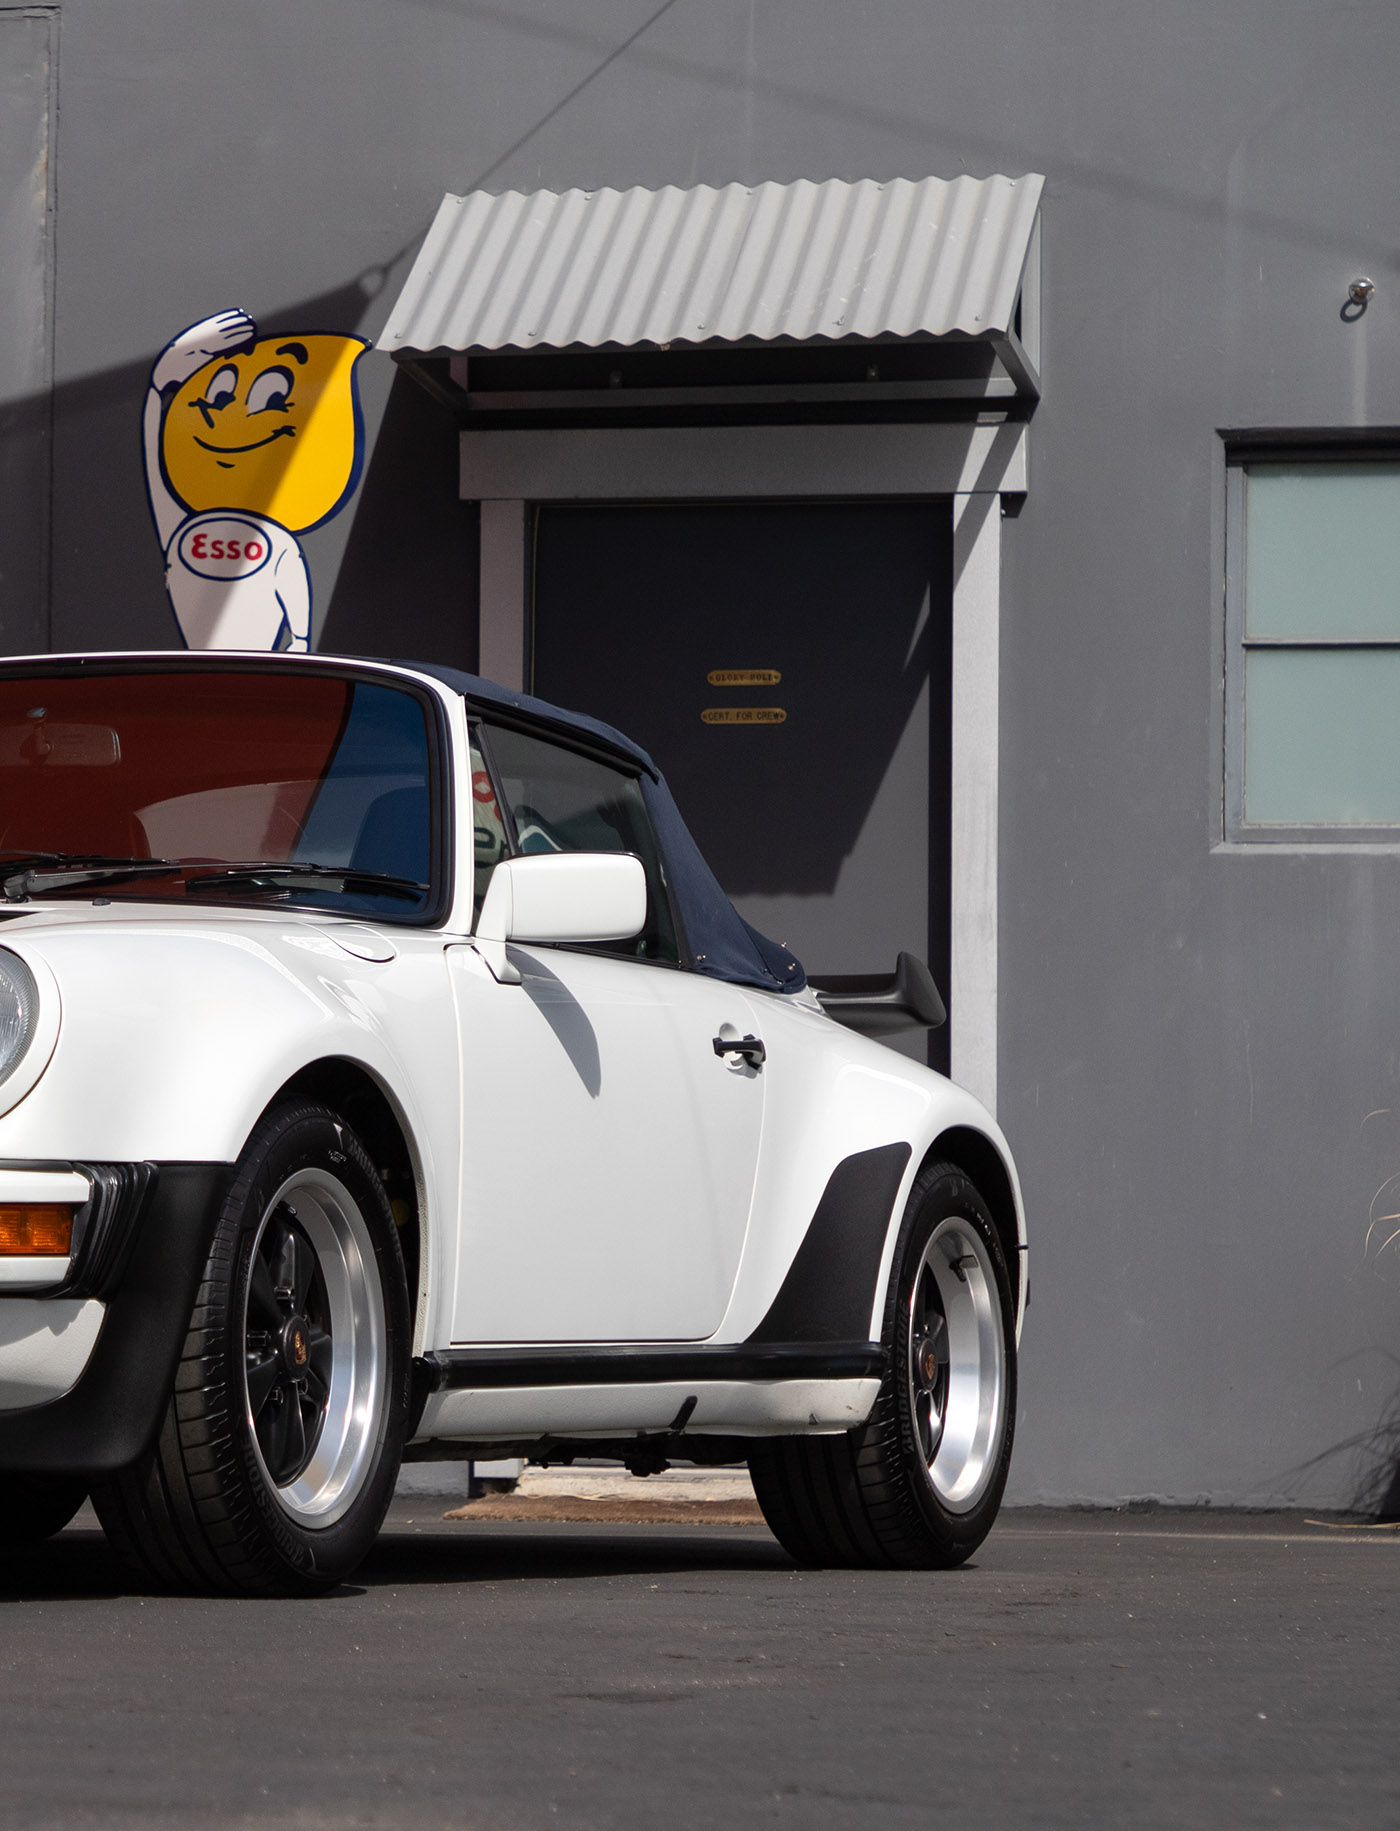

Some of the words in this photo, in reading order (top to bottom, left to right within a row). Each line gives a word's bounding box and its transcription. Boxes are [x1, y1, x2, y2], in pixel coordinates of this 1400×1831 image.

[191, 533, 264, 561] Esso
[715, 674, 745, 682] GLORY
[736, 711, 753, 720] FOR
[757, 711, 780, 720] CREW
[896, 1299, 916, 1454] BRIDGESTONE
